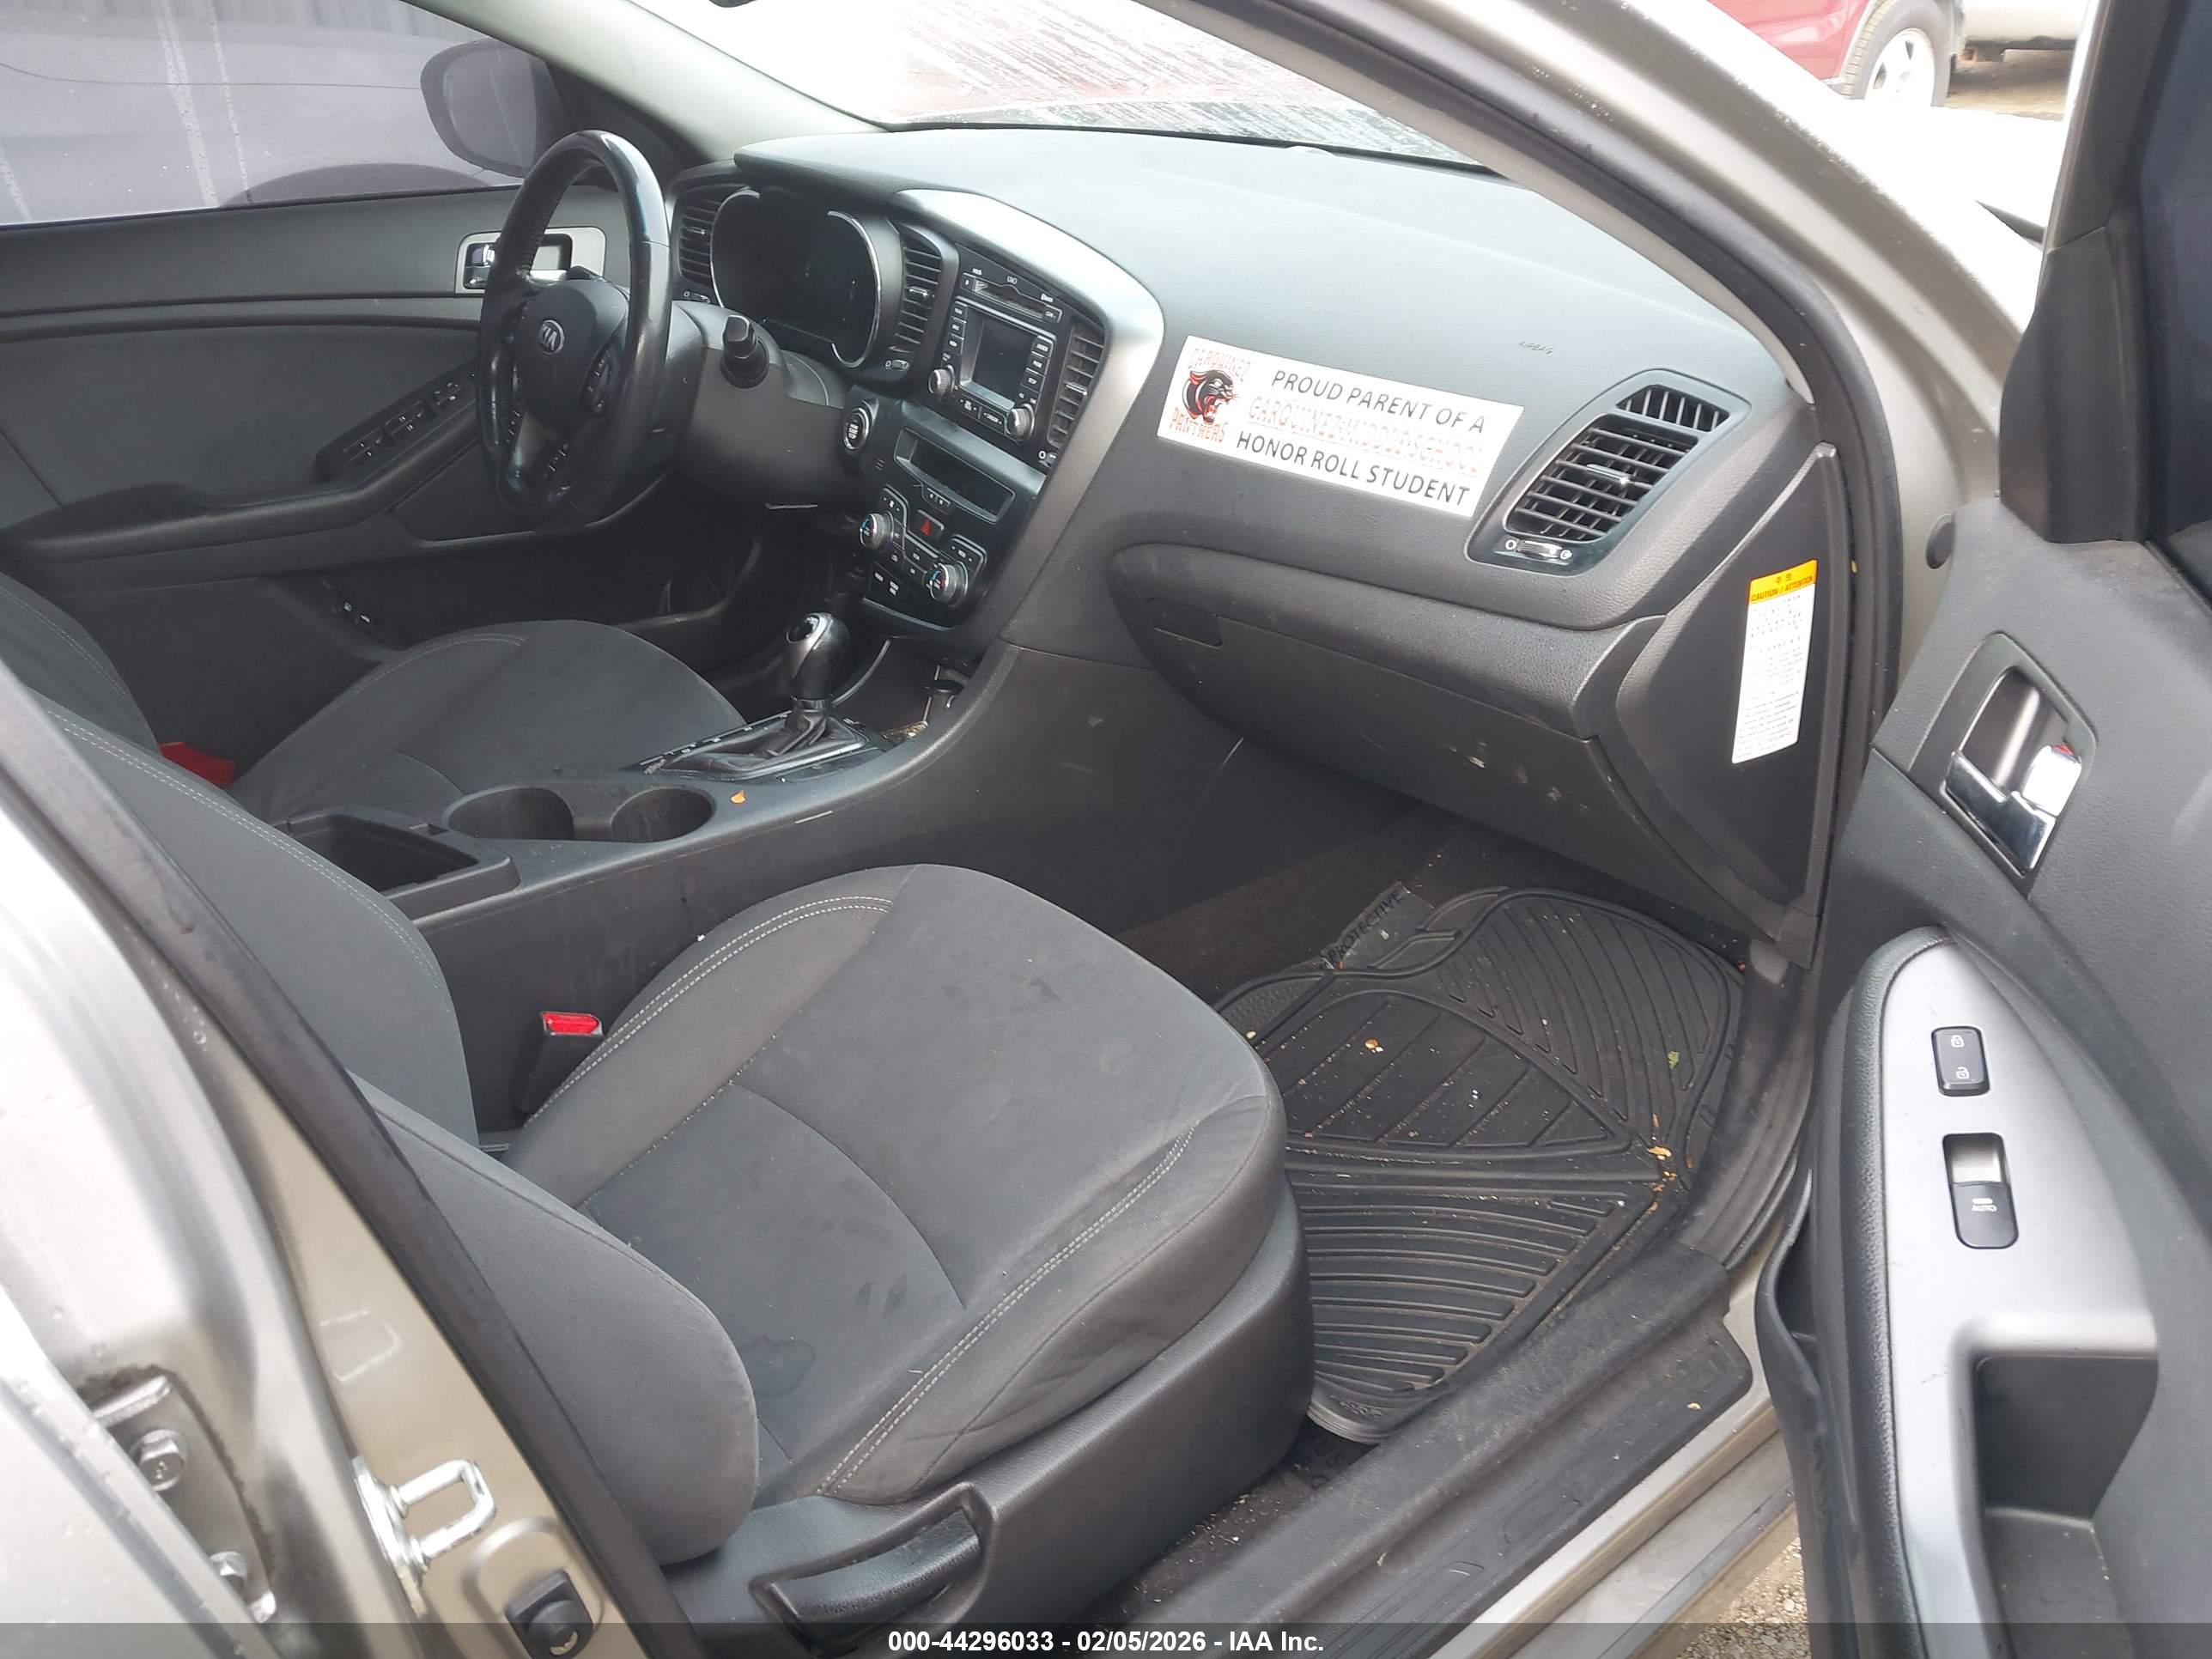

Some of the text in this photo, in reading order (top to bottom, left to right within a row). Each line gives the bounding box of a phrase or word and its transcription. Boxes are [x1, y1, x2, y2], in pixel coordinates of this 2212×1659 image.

[1272, 370, 1485, 434] PROUD PARENT OF A
[1237, 430, 1470, 506] HONOR ROLL STUDENT
[1751, 588, 1778, 602] CAUTION
